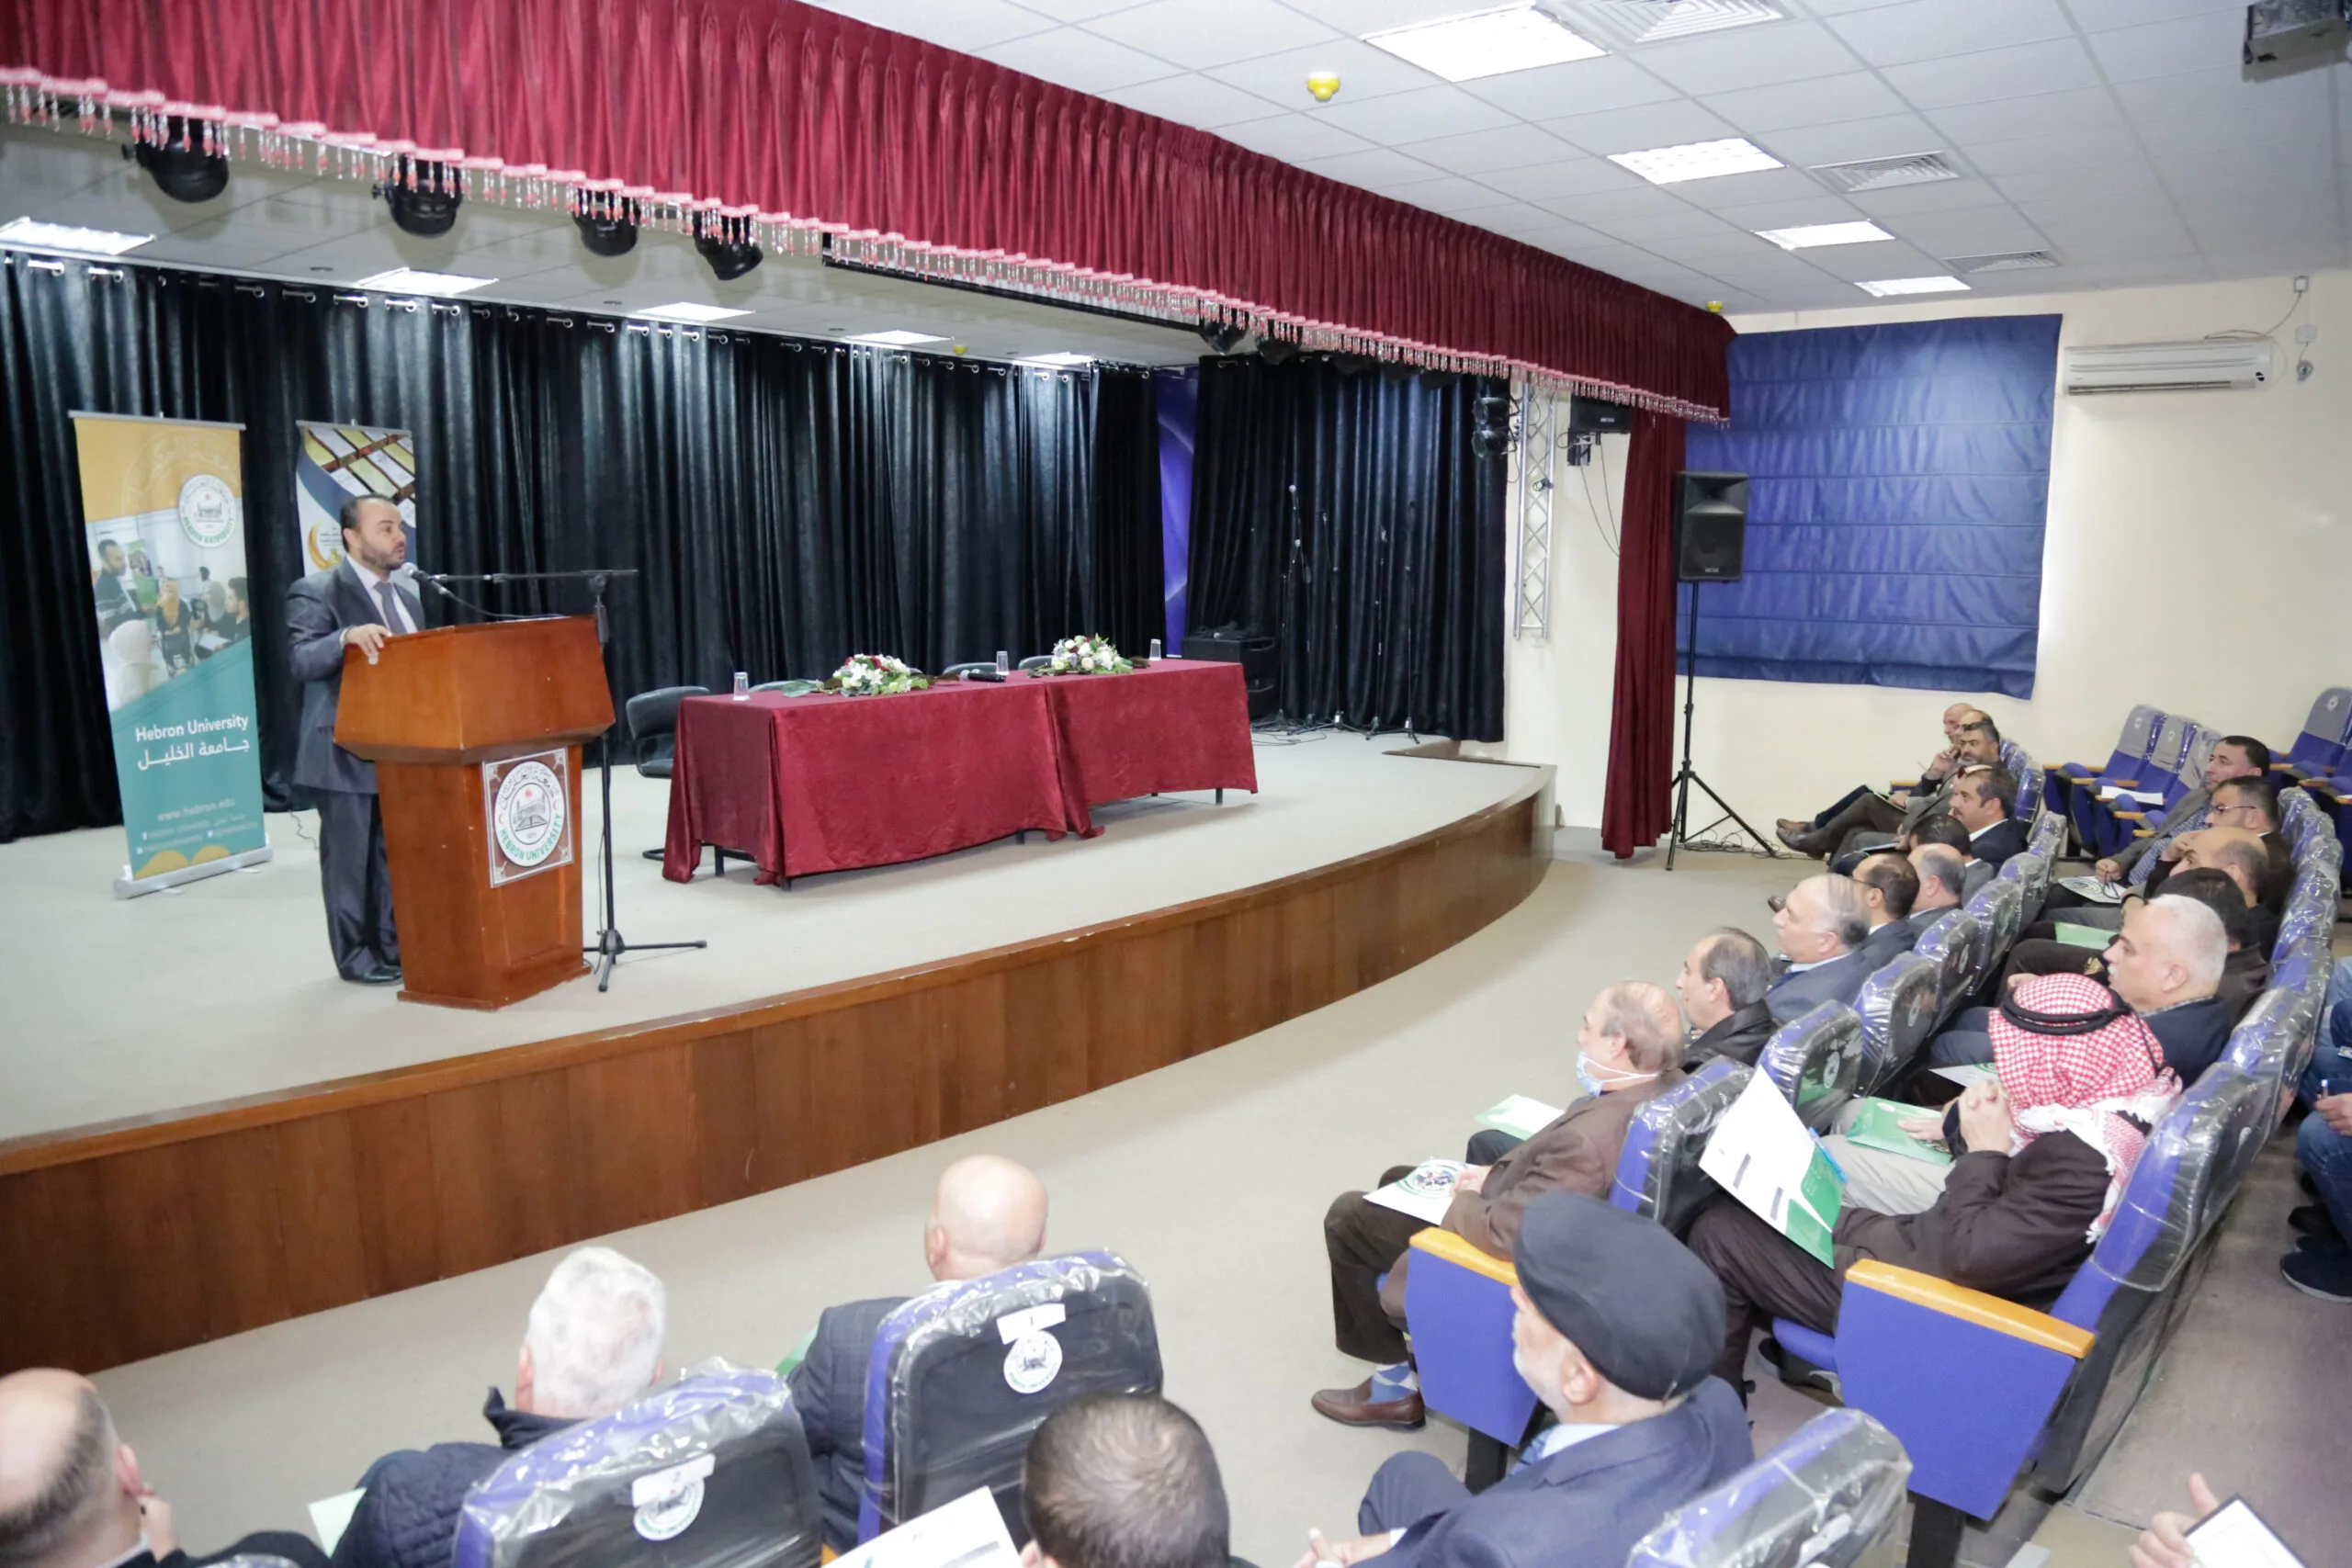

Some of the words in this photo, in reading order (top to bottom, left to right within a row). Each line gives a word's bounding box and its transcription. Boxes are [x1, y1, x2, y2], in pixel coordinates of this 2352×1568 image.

[136, 724, 185, 742] Hebron
[187, 715, 249, 734] University
[138, 742, 194, 771] الخليل
[198, 737, 250, 756] جامعة
[500, 828, 525, 860] HEBRON
[526, 814, 562, 861] UNIVERSITY
